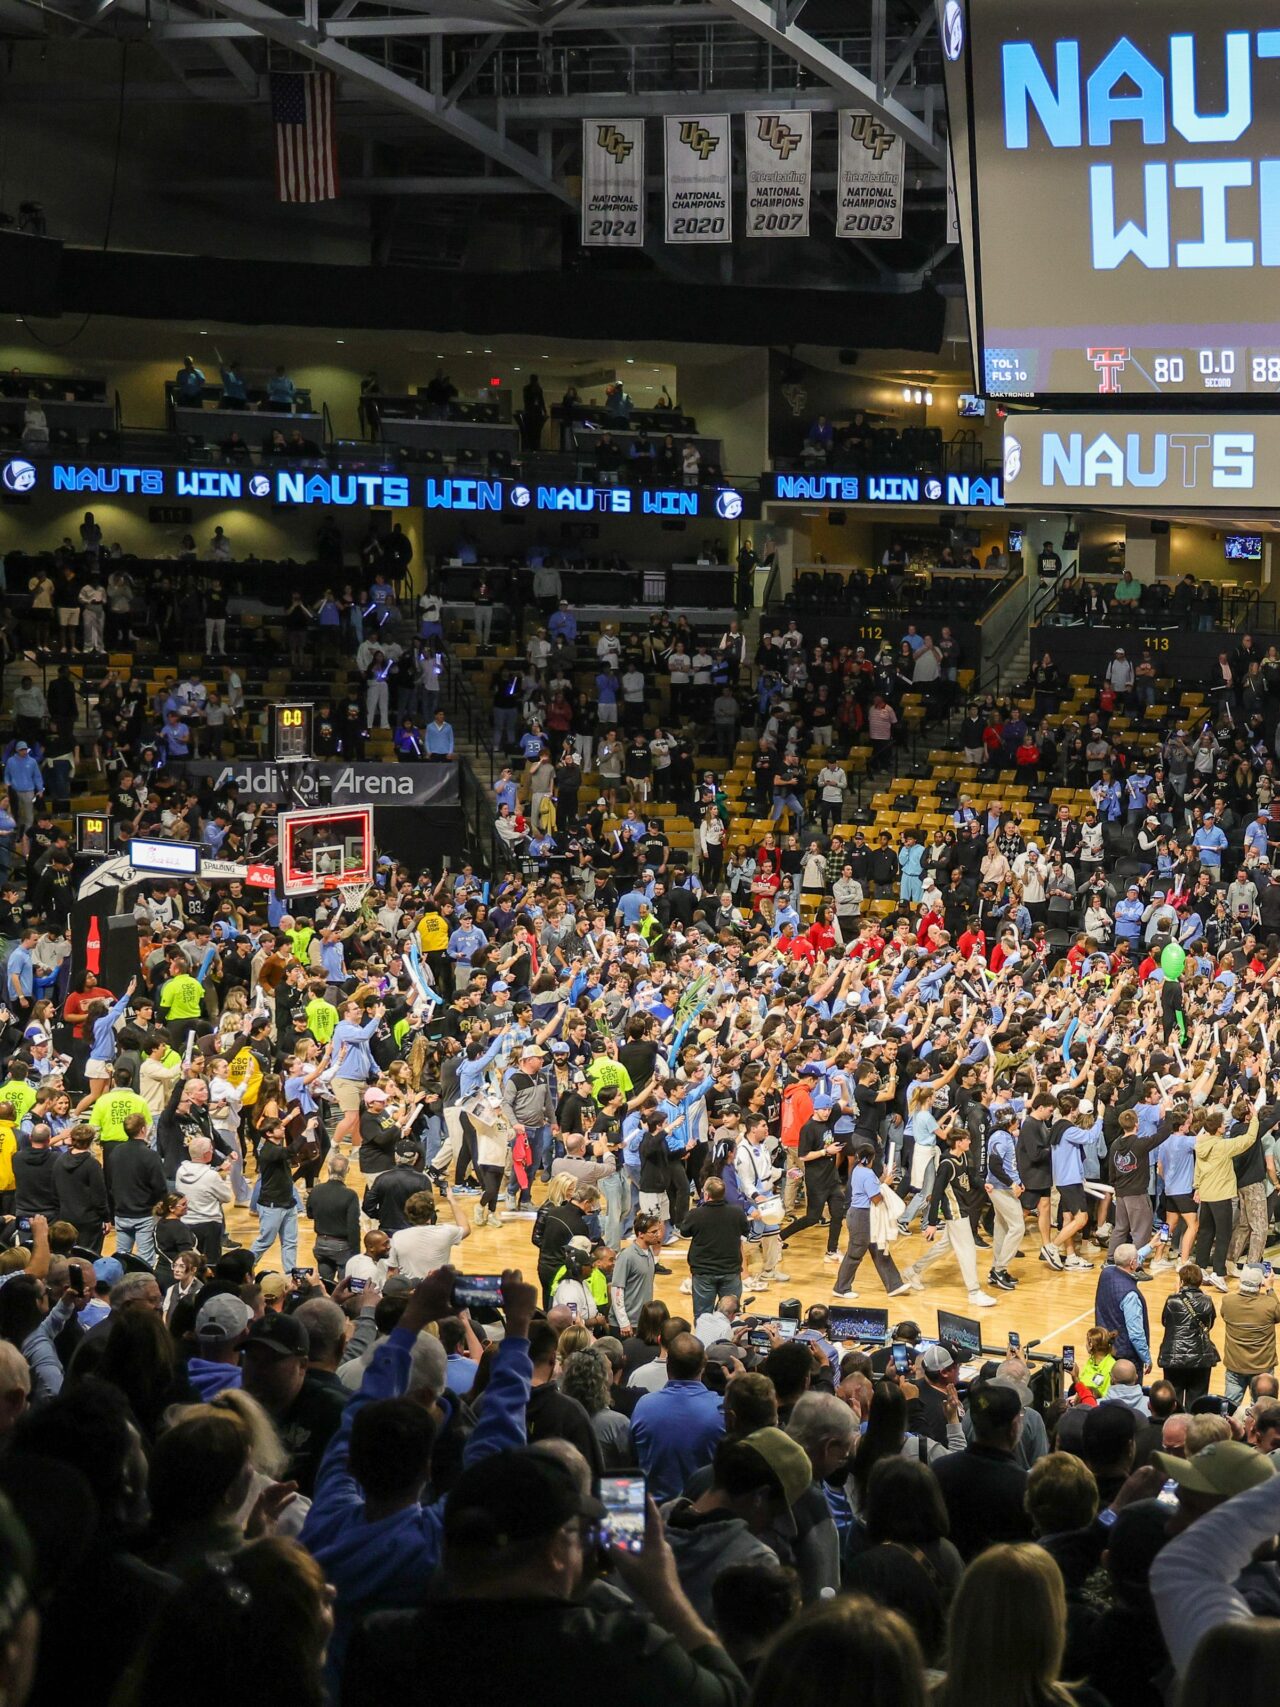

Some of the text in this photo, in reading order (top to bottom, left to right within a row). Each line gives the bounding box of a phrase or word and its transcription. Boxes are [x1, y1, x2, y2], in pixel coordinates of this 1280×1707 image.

[678, 121, 720, 160] UCF
[755, 116, 802, 160] UCF
[850, 115, 896, 160] UCF
[596, 125, 634, 164] UCF
[675, 191, 722, 201] NATIONAL
[756, 187, 801, 197] NATIONAL
[847, 187, 894, 198] NATIONAL
[592, 195, 634, 204] NATIONAL
[672, 200, 726, 210] CHAMPIONS
[749, 197, 805, 208] CHAMPIONS
[842, 197, 897, 208] CHAMPIONS
[588, 203, 639, 212] CHAMPIONS
[589, 219, 637, 237] 2024
[673, 216, 725, 234] 2020
[752, 213, 803, 231] 2007
[844, 213, 894, 232] 2003
[992, 359, 1012, 369] TOL
[1200, 350, 1235, 374] 0.0
[992, 371, 1027, 381] FLS 10
[1154, 358, 1183, 383] 80
[1205, 378, 1231, 388] SECOND
[1041, 432, 1255, 489] NAUTS
[53, 465, 241, 497] NAUTS WIN
[278, 472, 502, 510] NAUTS WIN
[777, 475, 919, 501] NAUTS WIN
[537, 485, 698, 515] NAUTS WIN
[859, 627, 882, 639] 112
[333, 767, 414, 794] Arena
[203, 861, 236, 873] SPALDING
[188, 901, 201, 913] 83
[231, 1057, 247, 1065] CSC
[600, 1065, 617, 1075] CSC
[5, 1091, 24, 1100] CSC
[111, 1100, 132, 1109] CSC
[110, 1108, 132, 1117] EVENT
